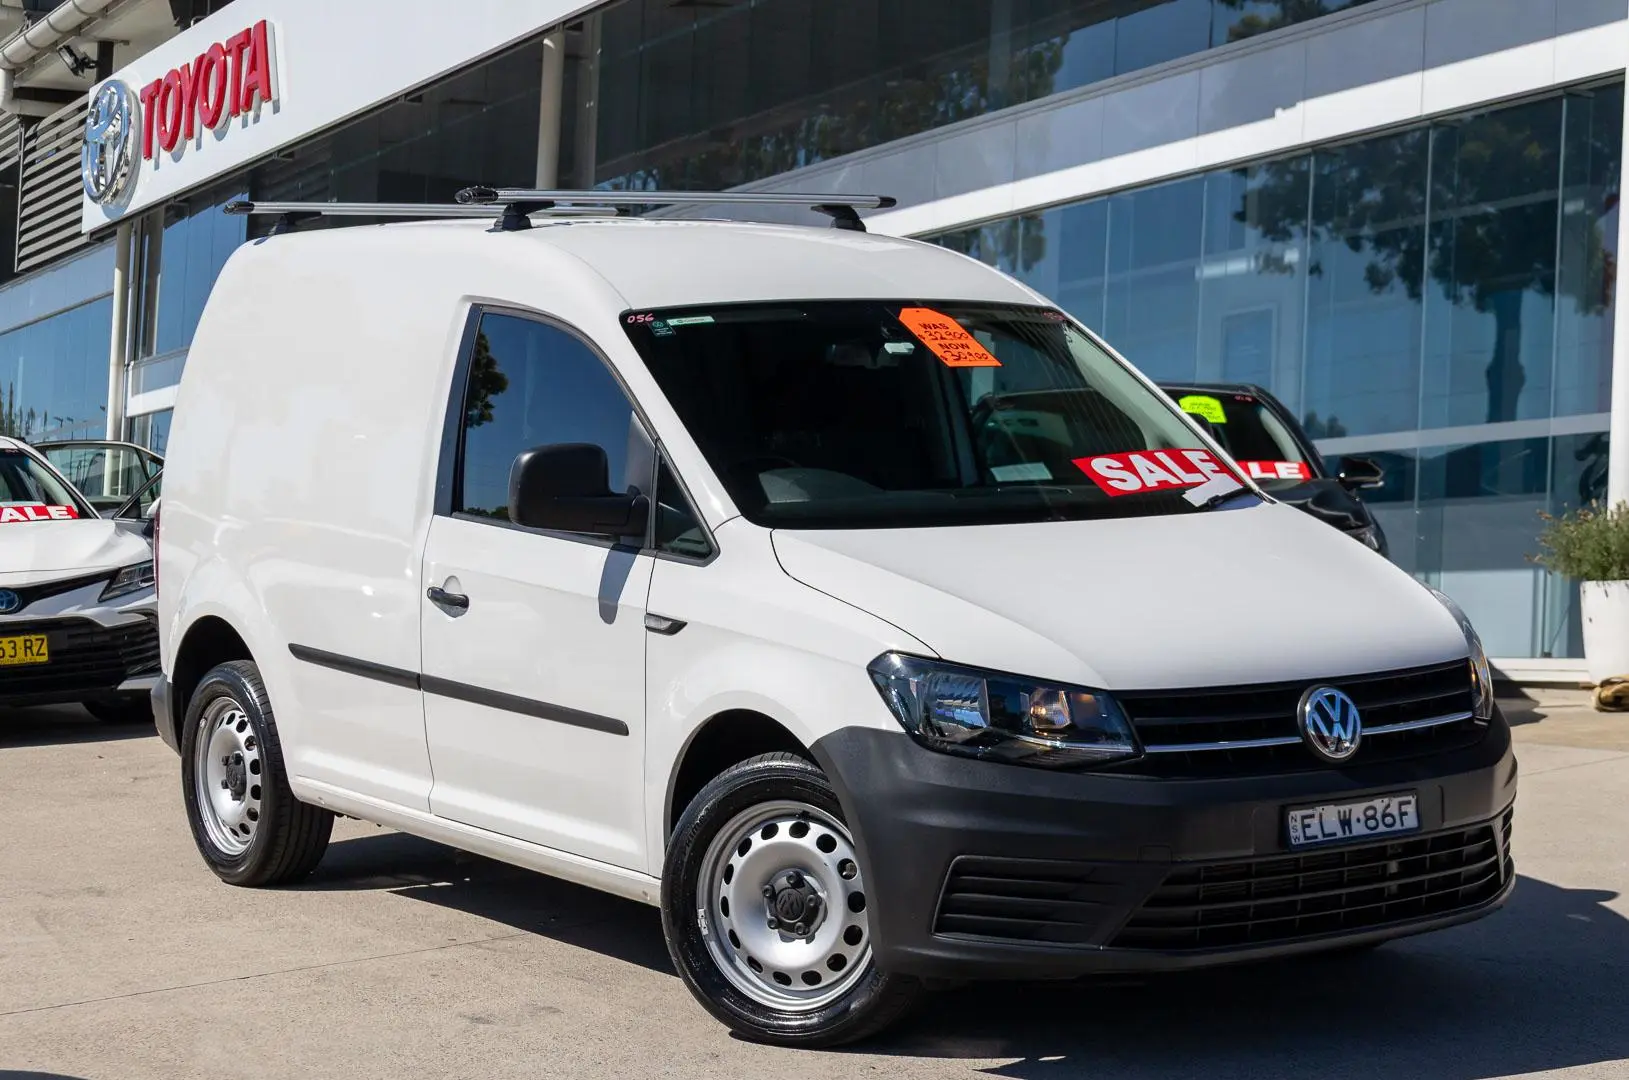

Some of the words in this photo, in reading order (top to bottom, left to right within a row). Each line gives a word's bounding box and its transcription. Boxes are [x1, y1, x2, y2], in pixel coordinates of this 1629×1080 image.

[140, 20, 272, 161] TOYOTA
[1091, 451, 1220, 491] SALE
[1248, 462, 1304, 479] LE
[0, 506, 73, 522] ALE
